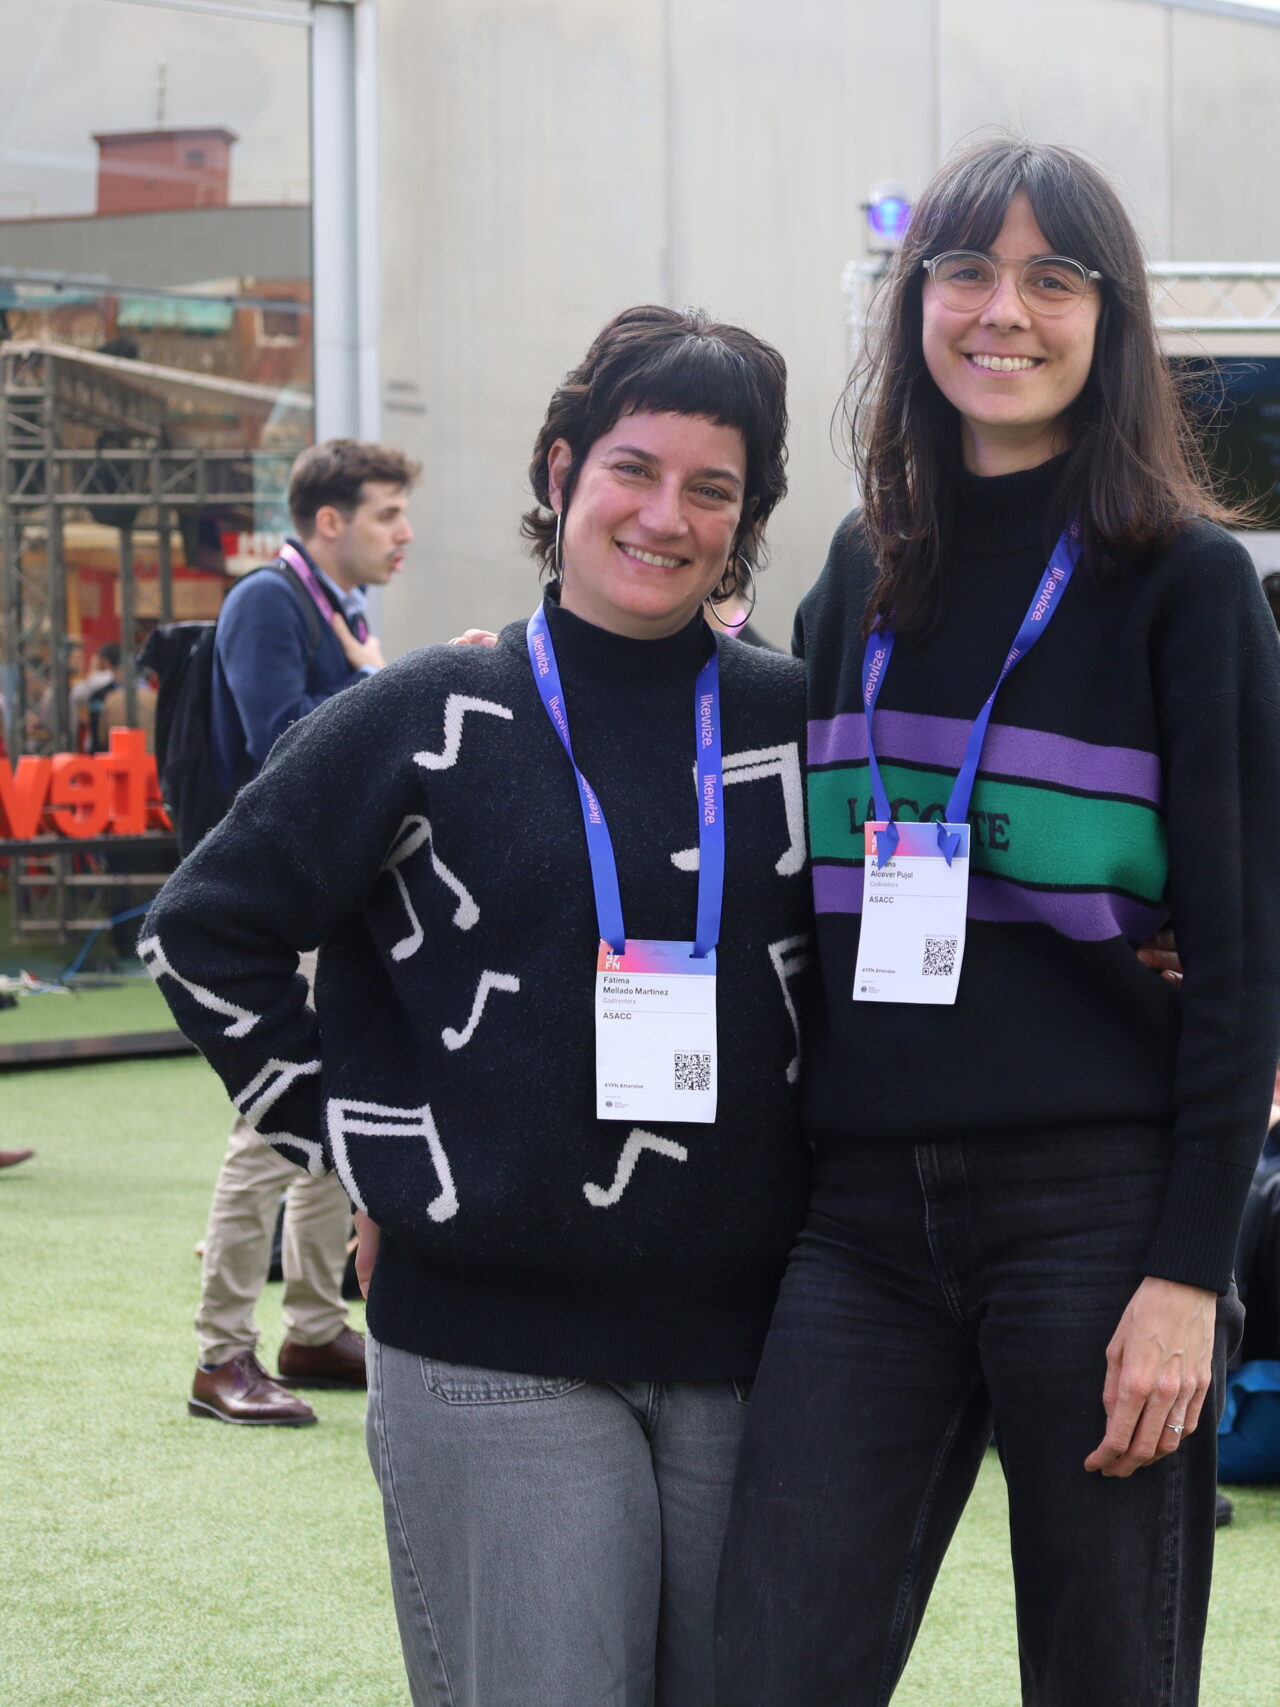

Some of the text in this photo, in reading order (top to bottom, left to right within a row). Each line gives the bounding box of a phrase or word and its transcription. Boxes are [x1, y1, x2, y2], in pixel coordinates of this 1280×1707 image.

[1031, 567, 1065, 621] likewize.
[532, 633, 550, 677] likewize.
[700, 694, 714, 749] likewize.
[703, 773, 718, 826] likewize.
[847, 795, 1011, 852] LCTE
[871, 860, 896, 868] Aana
[870, 870, 914, 880] Alcover Pujol
[869, 896, 894, 904] ASACC
[605, 961, 621, 970] FN
[603, 976, 630, 984] Fátima
[603, 986, 634, 995] Mellado
[603, 1012, 632, 1020] ASACC
